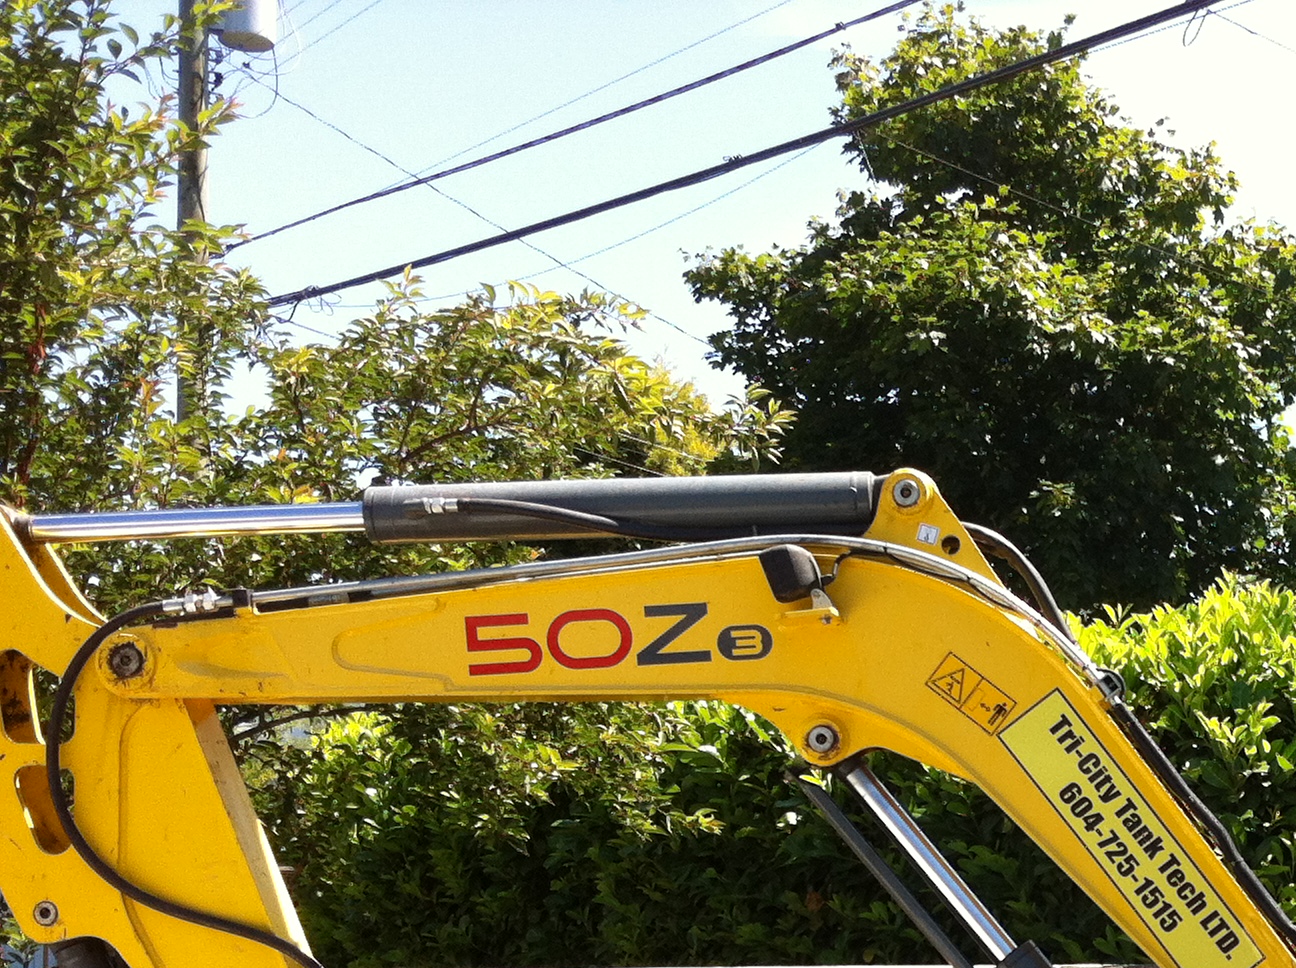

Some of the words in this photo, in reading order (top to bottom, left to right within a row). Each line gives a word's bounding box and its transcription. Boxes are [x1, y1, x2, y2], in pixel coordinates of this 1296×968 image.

[1049, 713, 1122, 804] Tri-City
[1114, 797, 1165, 861] Tank
[1157, 852, 1208, 916] Tech
[1199, 909, 1241, 961] LTD.
[1058, 781, 1184, 934] 604-725-1515
